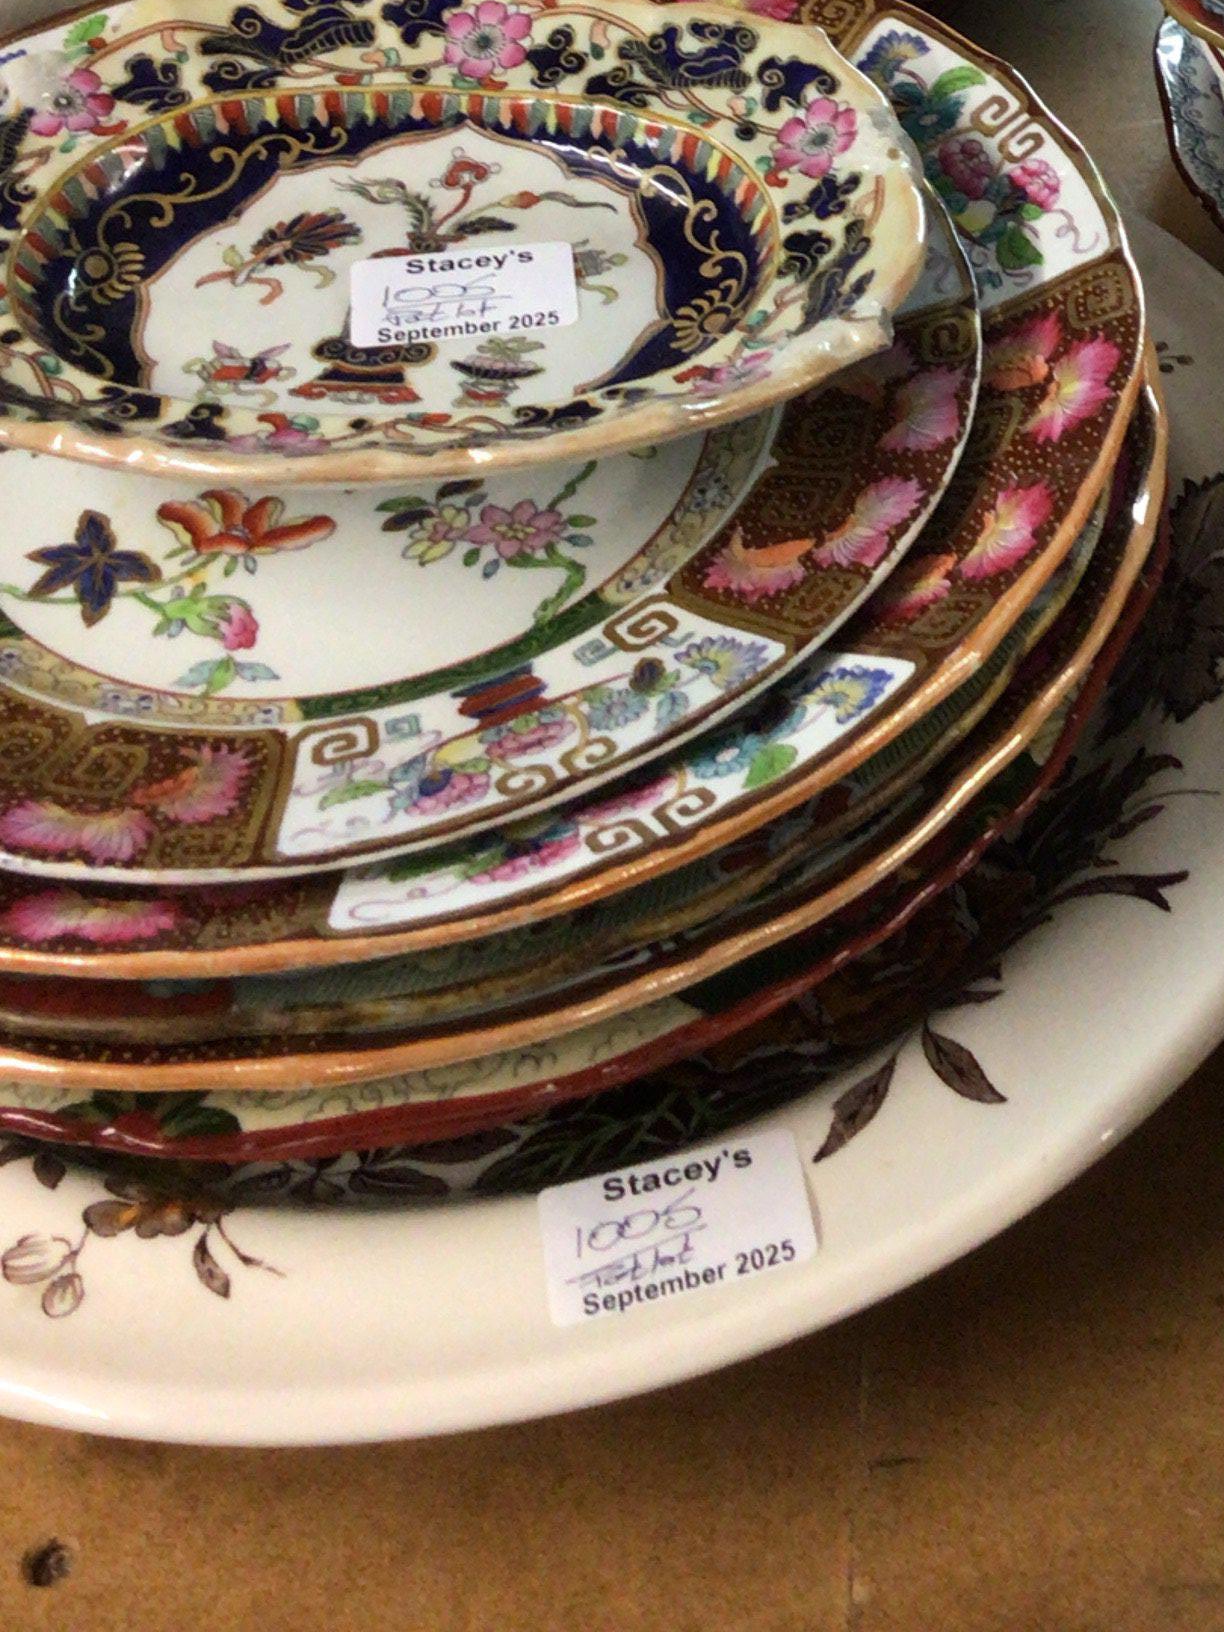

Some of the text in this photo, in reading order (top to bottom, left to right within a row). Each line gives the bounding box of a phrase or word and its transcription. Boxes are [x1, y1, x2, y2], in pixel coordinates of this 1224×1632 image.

[406, 249, 534, 275] Stacey's
[377, 310, 560, 345] September 2025
[602, 1147, 753, 1202] Stacey's
[574, 1187, 702, 1259] 1005
[582, 1238, 796, 1317] September 2025
